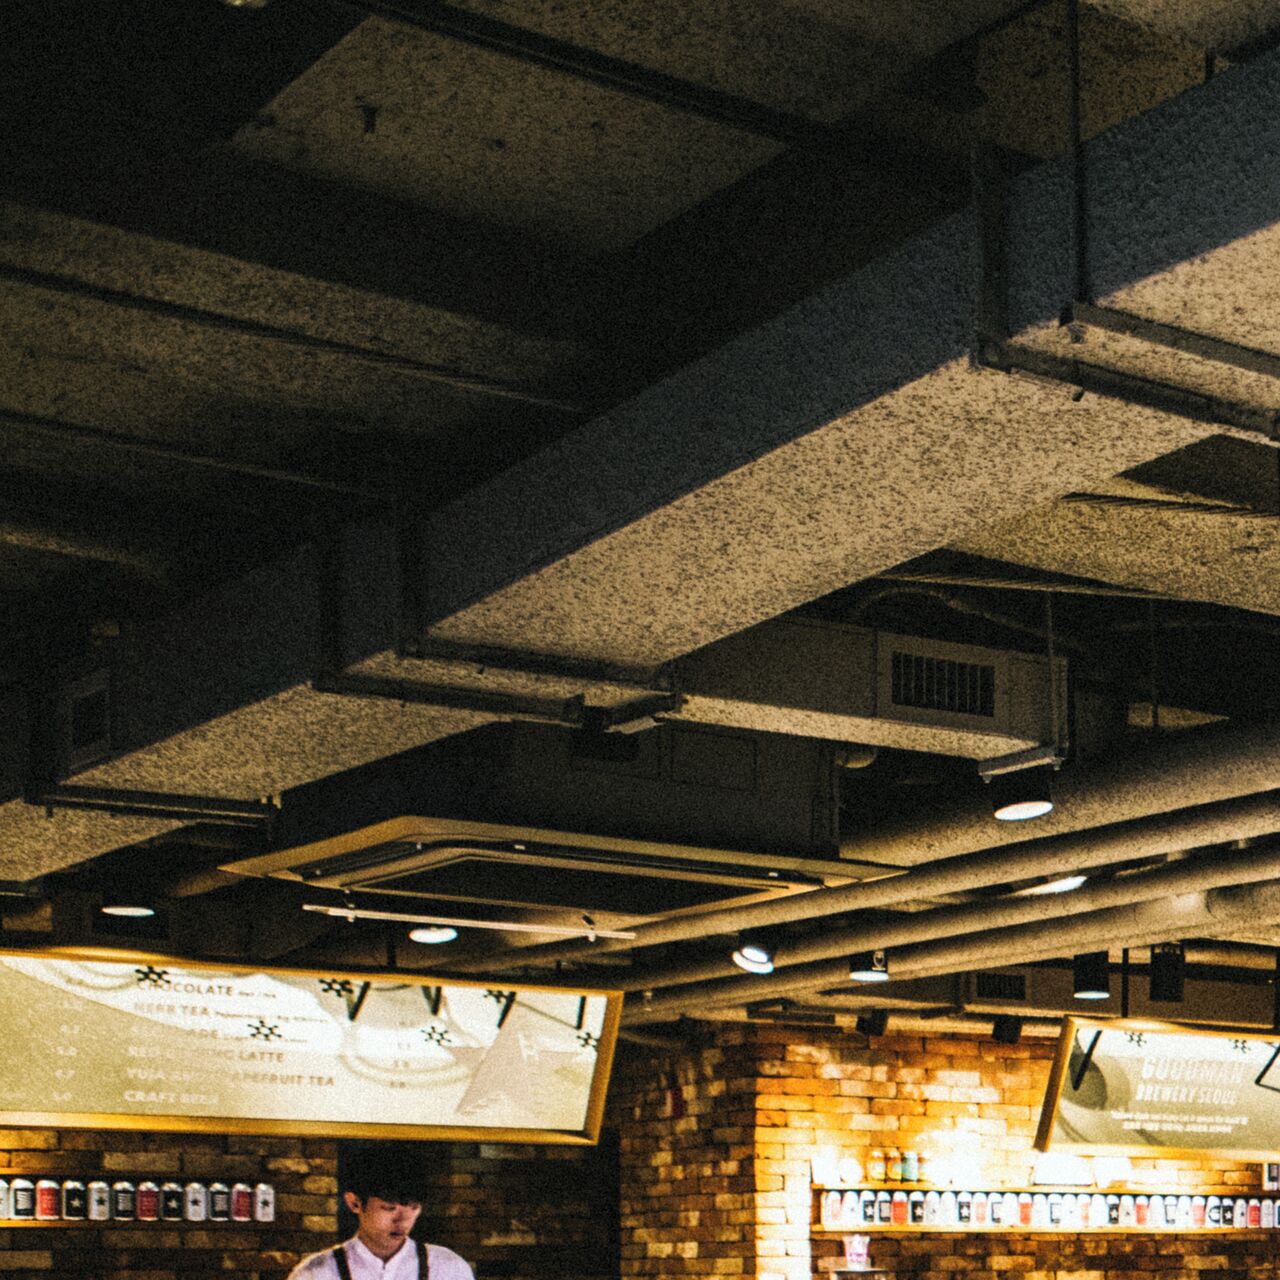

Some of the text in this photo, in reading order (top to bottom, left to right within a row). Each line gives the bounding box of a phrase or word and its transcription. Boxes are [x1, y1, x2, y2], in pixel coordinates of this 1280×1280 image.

[181, 1004, 210, 1017] TEA
[239, 1051, 285, 1063] LATTE
[309, 1074, 335, 1086] TEA
[1135, 1083, 1197, 1102] BREWERY
